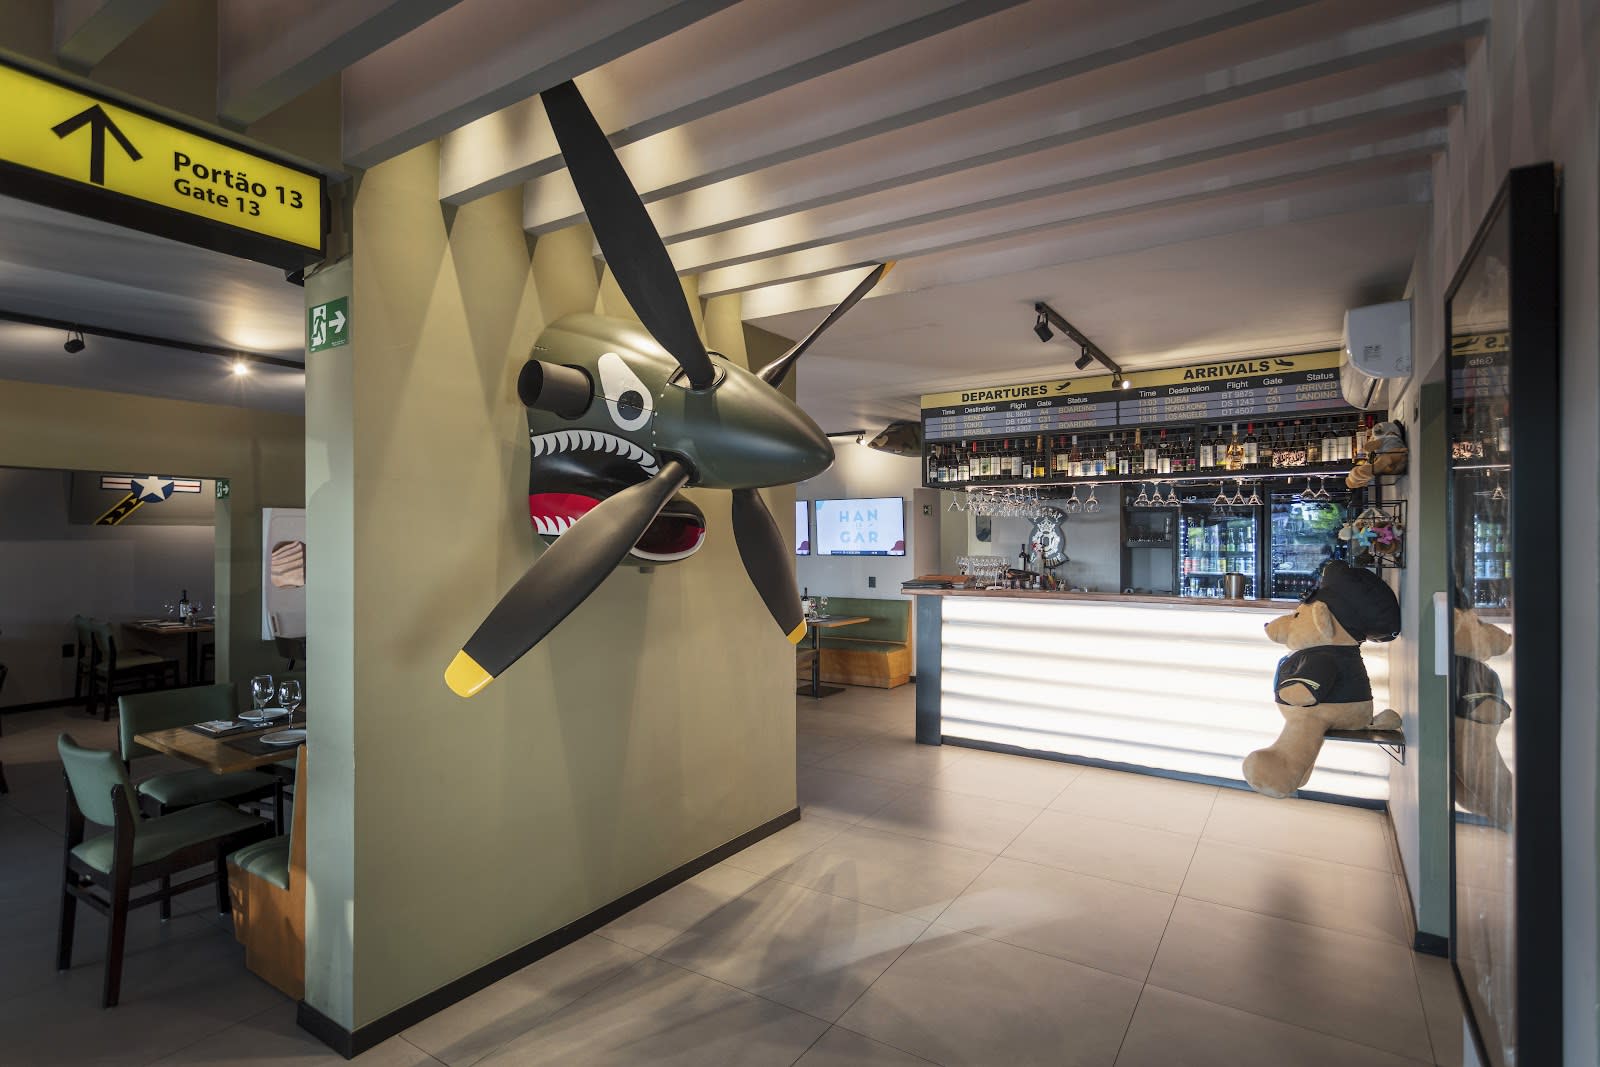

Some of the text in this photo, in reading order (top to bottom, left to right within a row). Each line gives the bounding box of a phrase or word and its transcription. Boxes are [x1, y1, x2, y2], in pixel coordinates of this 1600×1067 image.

[174, 151, 303, 209] Portão 13
[174, 178, 261, 216] Gate 13
[1183, 360, 1270, 380] ARRIVALS
[1139, 373, 1335, 398] Time Destination Flight Gate Status
[1296, 382, 1338, 393] ARRIVED
[961, 385, 1048, 402] DEPARTURES
[964, 406, 996, 414] Destination
[1010, 402, 1027, 410] Flight
[1058, 404, 1097, 414] BOARDING
[1164, 404, 1185, 413] HONG
[1186, 401, 1207, 410] KONG
[1296, 391, 1338, 402] LANDING
[1178, 410, 1208, 419] ANGELES
[1058, 419, 1097, 429] BOARDING
[839, 508, 878, 523] HAN
[839, 531, 878, 544] GAR
